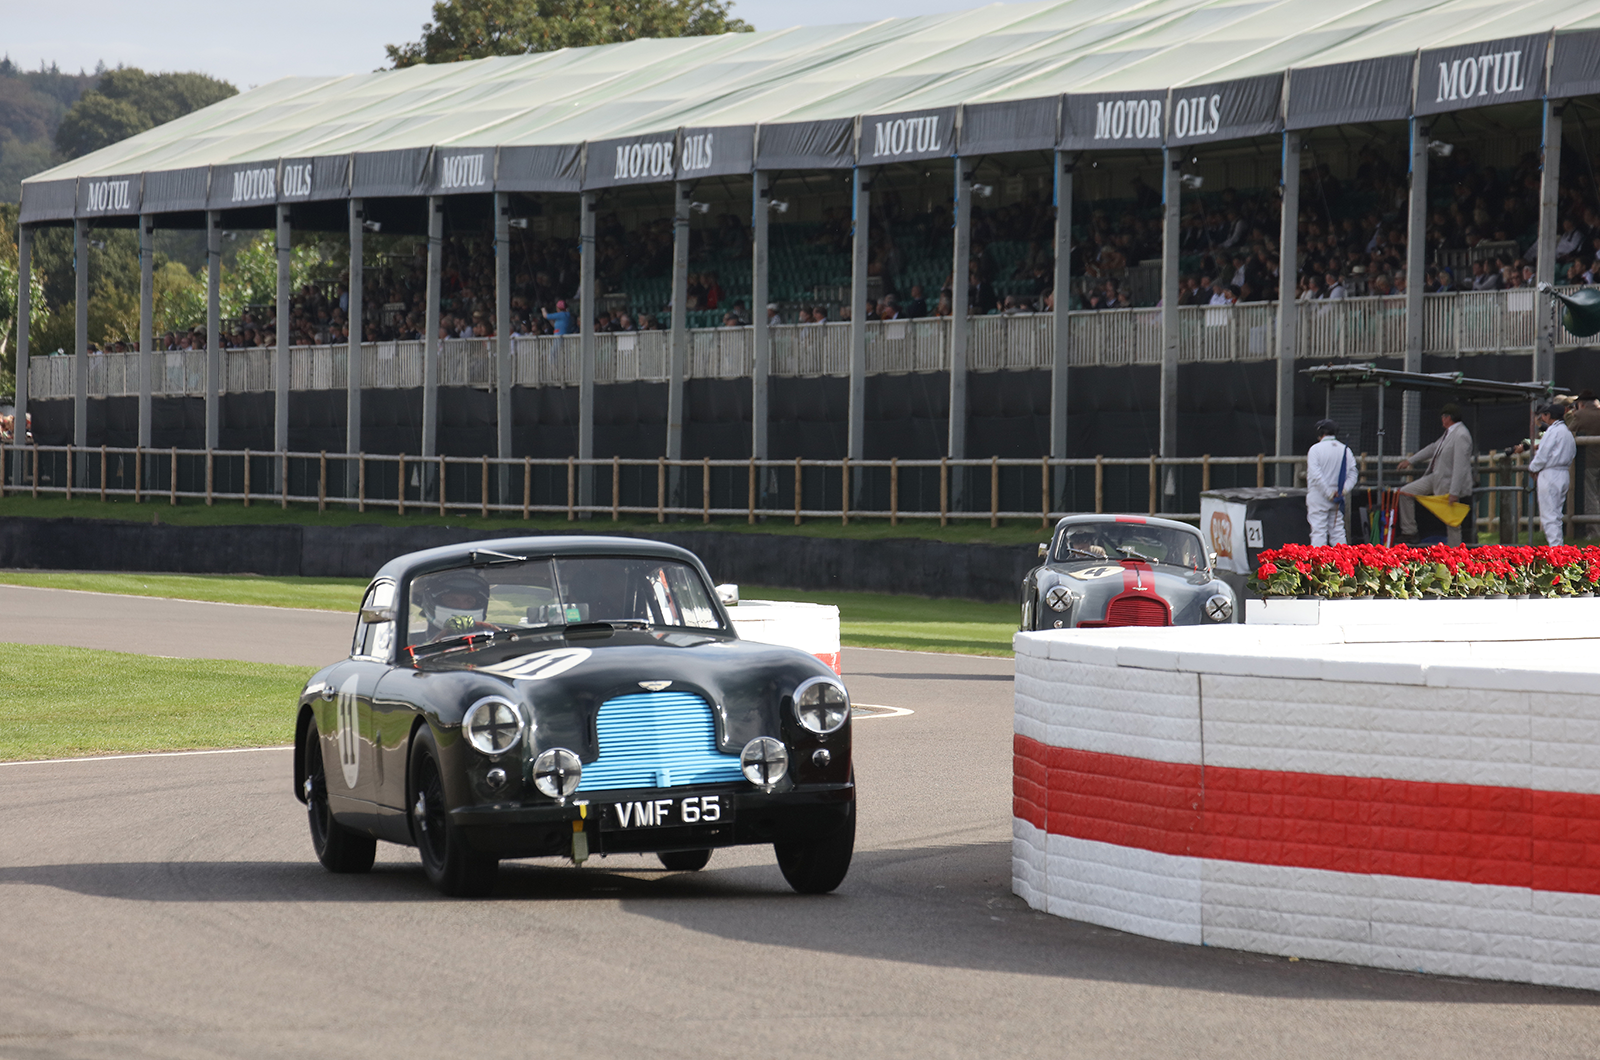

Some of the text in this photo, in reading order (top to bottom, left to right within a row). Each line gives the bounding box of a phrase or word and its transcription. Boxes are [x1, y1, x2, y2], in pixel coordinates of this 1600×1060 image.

[1435, 50, 1524, 103] MOTUL
[1094, 94, 1221, 139] MOTOR OILS
[614, 133, 713, 179] MOTOR OILS
[873, 116, 941, 157] MOTUL
[231, 165, 312, 202] MOTOR OILS
[441, 154, 485, 188] MOTUL
[86, 180, 131, 212] MOTUL
[1249, 527, 1262, 541] 21
[341, 694, 355, 765] 11
[614, 795, 720, 828] VMF 65
